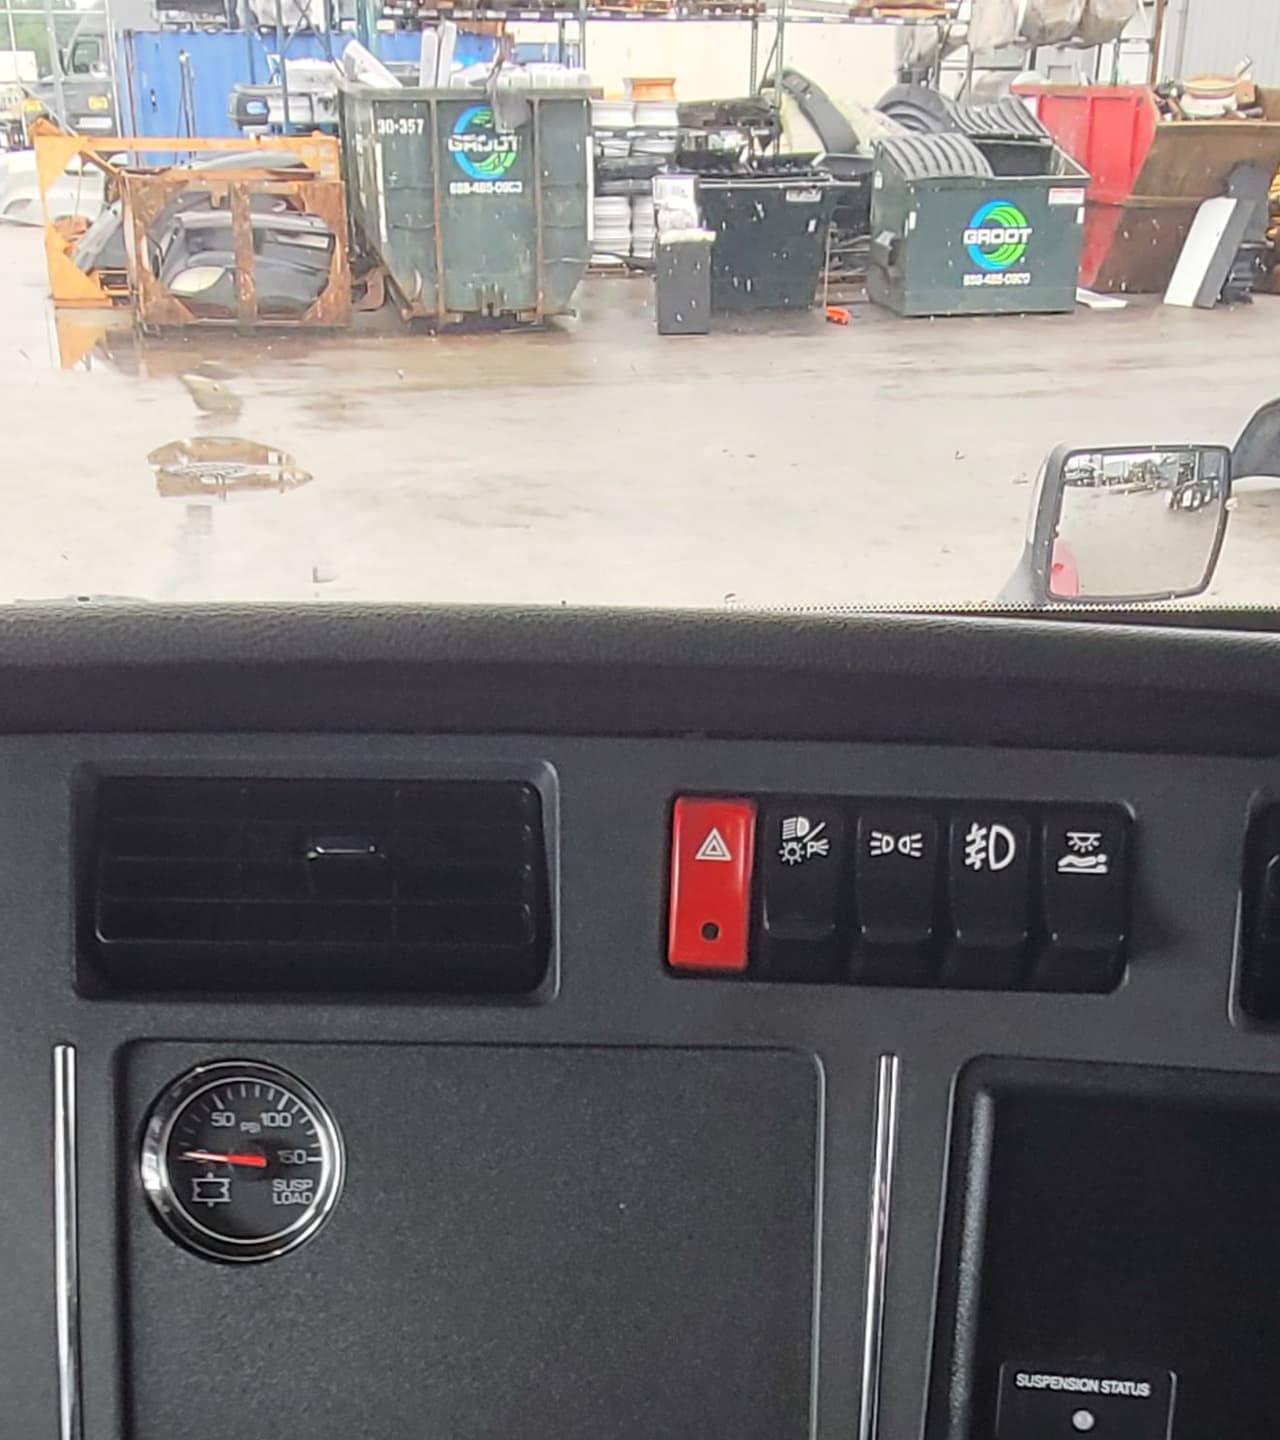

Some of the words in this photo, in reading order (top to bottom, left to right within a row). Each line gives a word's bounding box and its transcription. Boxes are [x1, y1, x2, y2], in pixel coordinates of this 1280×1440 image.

[963, 228, 1032, 245] GROOT
[211, 1112, 235, 1127] 50
[240, 1121, 261, 1133] PSI
[260, 1112, 292, 1127] 100
[272, 1179, 313, 1192] SUSP
[272, 1192, 313, 1205] LOAD
[1016, 1372, 1099, 1393] SUSPENSION
[1100, 1379, 1151, 1398] STATUS
